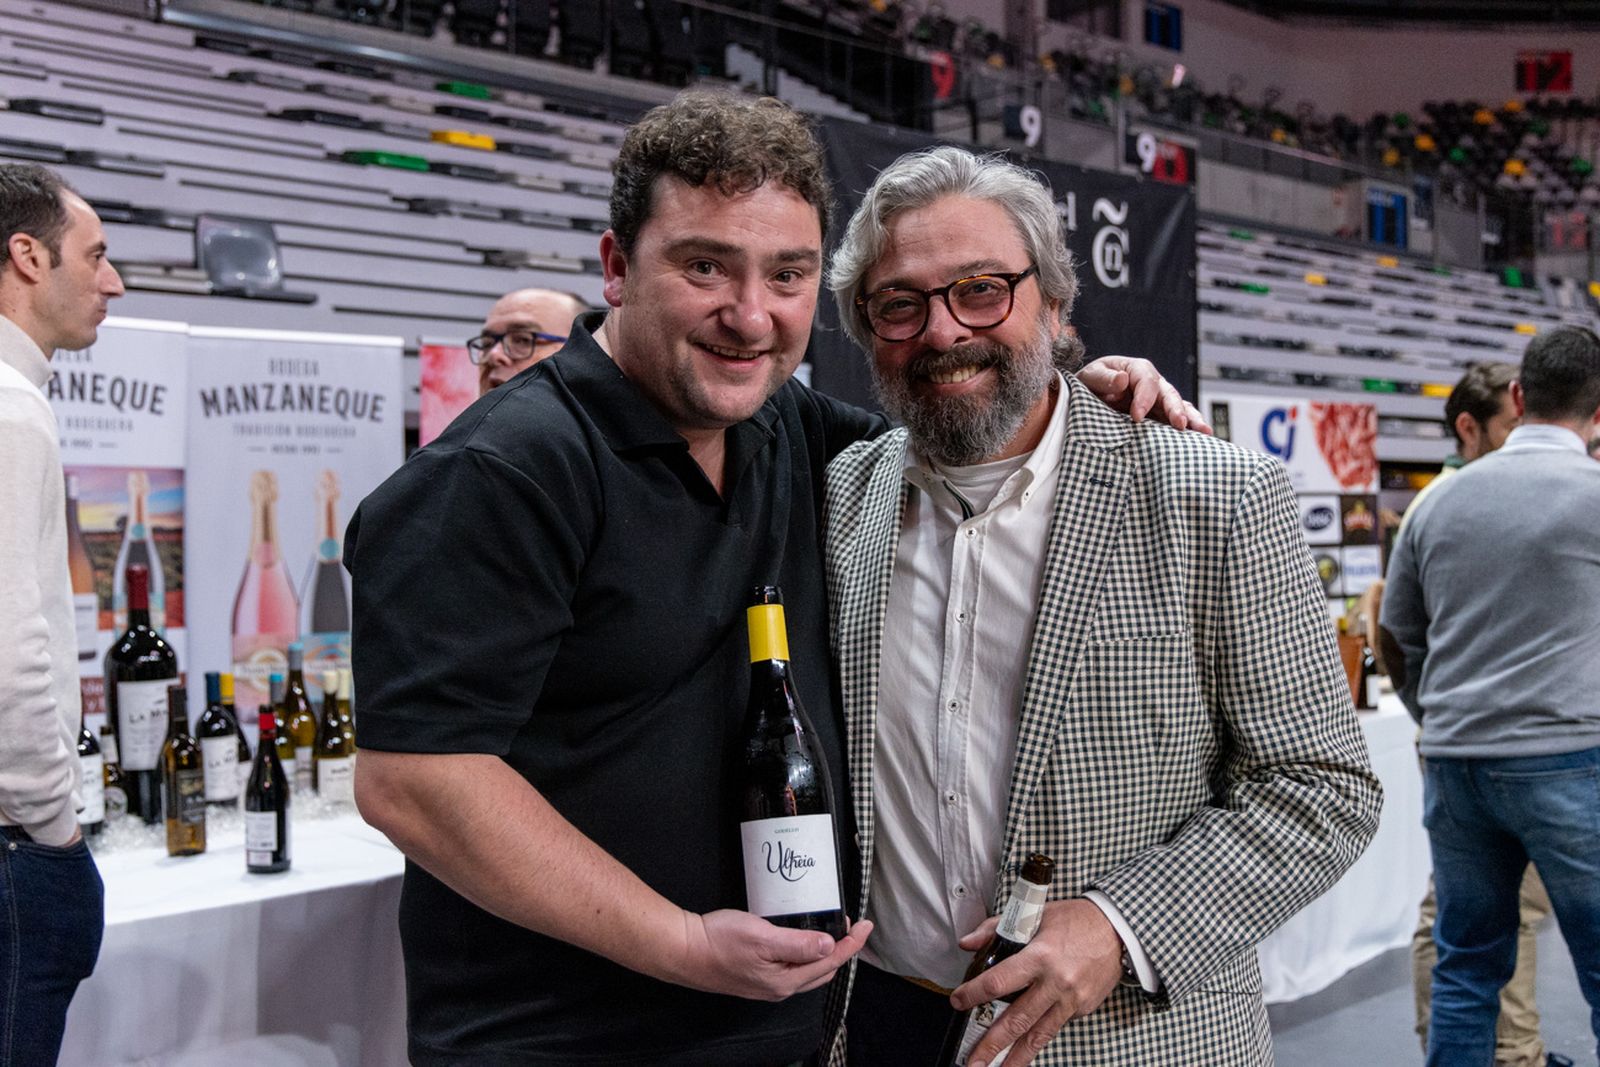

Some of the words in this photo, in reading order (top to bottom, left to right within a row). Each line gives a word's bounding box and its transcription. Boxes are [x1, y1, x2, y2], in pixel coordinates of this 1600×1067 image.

[1020, 105, 1042, 147] 9
[1136, 133, 1156, 172] 9
[48, 371, 167, 415] ANEQUE
[200, 384, 385, 422] MANZANEQUE
[762, 841, 816, 881] Ultreia
